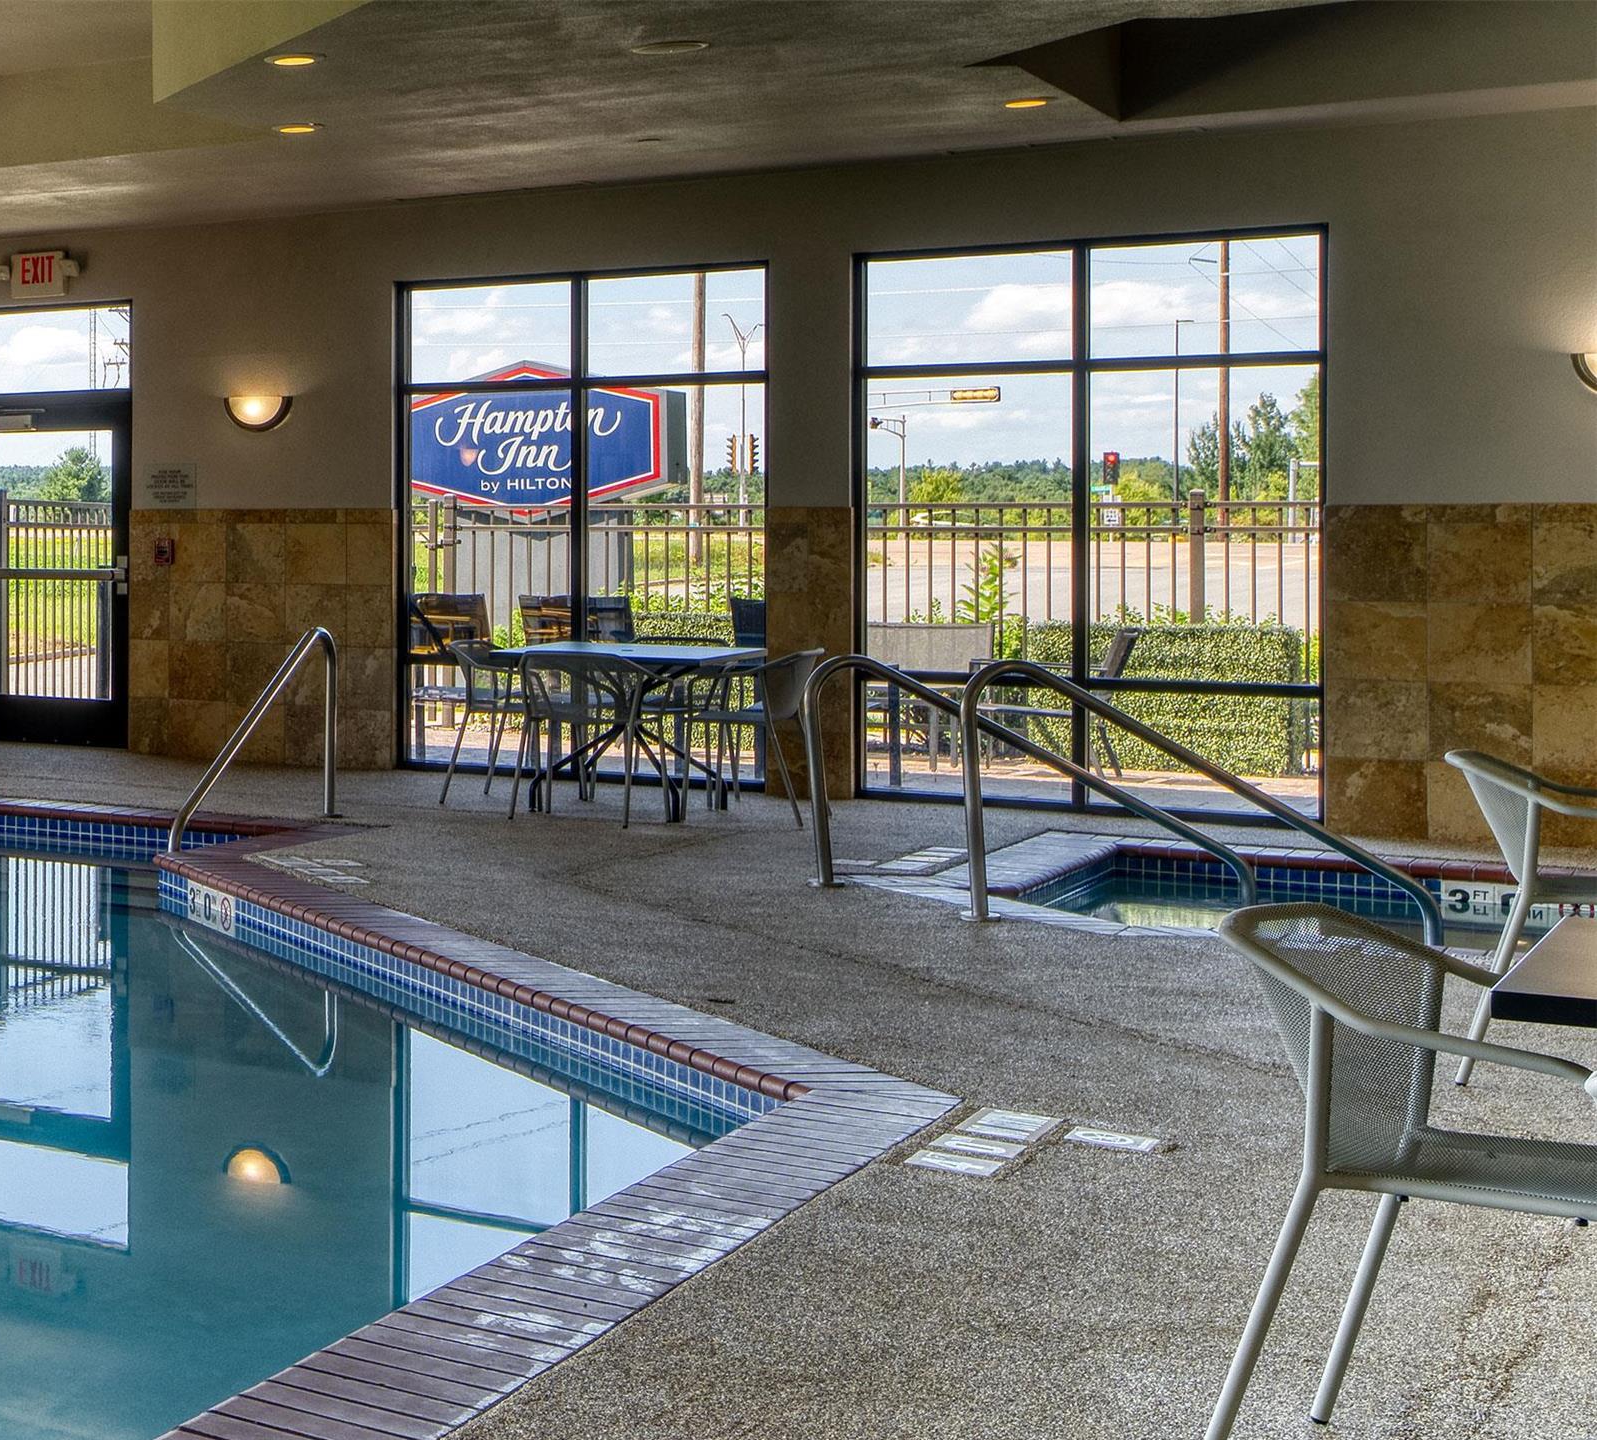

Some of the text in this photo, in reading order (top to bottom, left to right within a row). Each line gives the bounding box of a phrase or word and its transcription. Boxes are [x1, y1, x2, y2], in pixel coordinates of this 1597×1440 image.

[21, 255, 55, 285] EXIT
[477, 435, 571, 476] Inn
[480, 477, 571, 493] by HILTON
[1448, 889, 1470, 909] 3
[1473, 890, 1489, 901] FT
